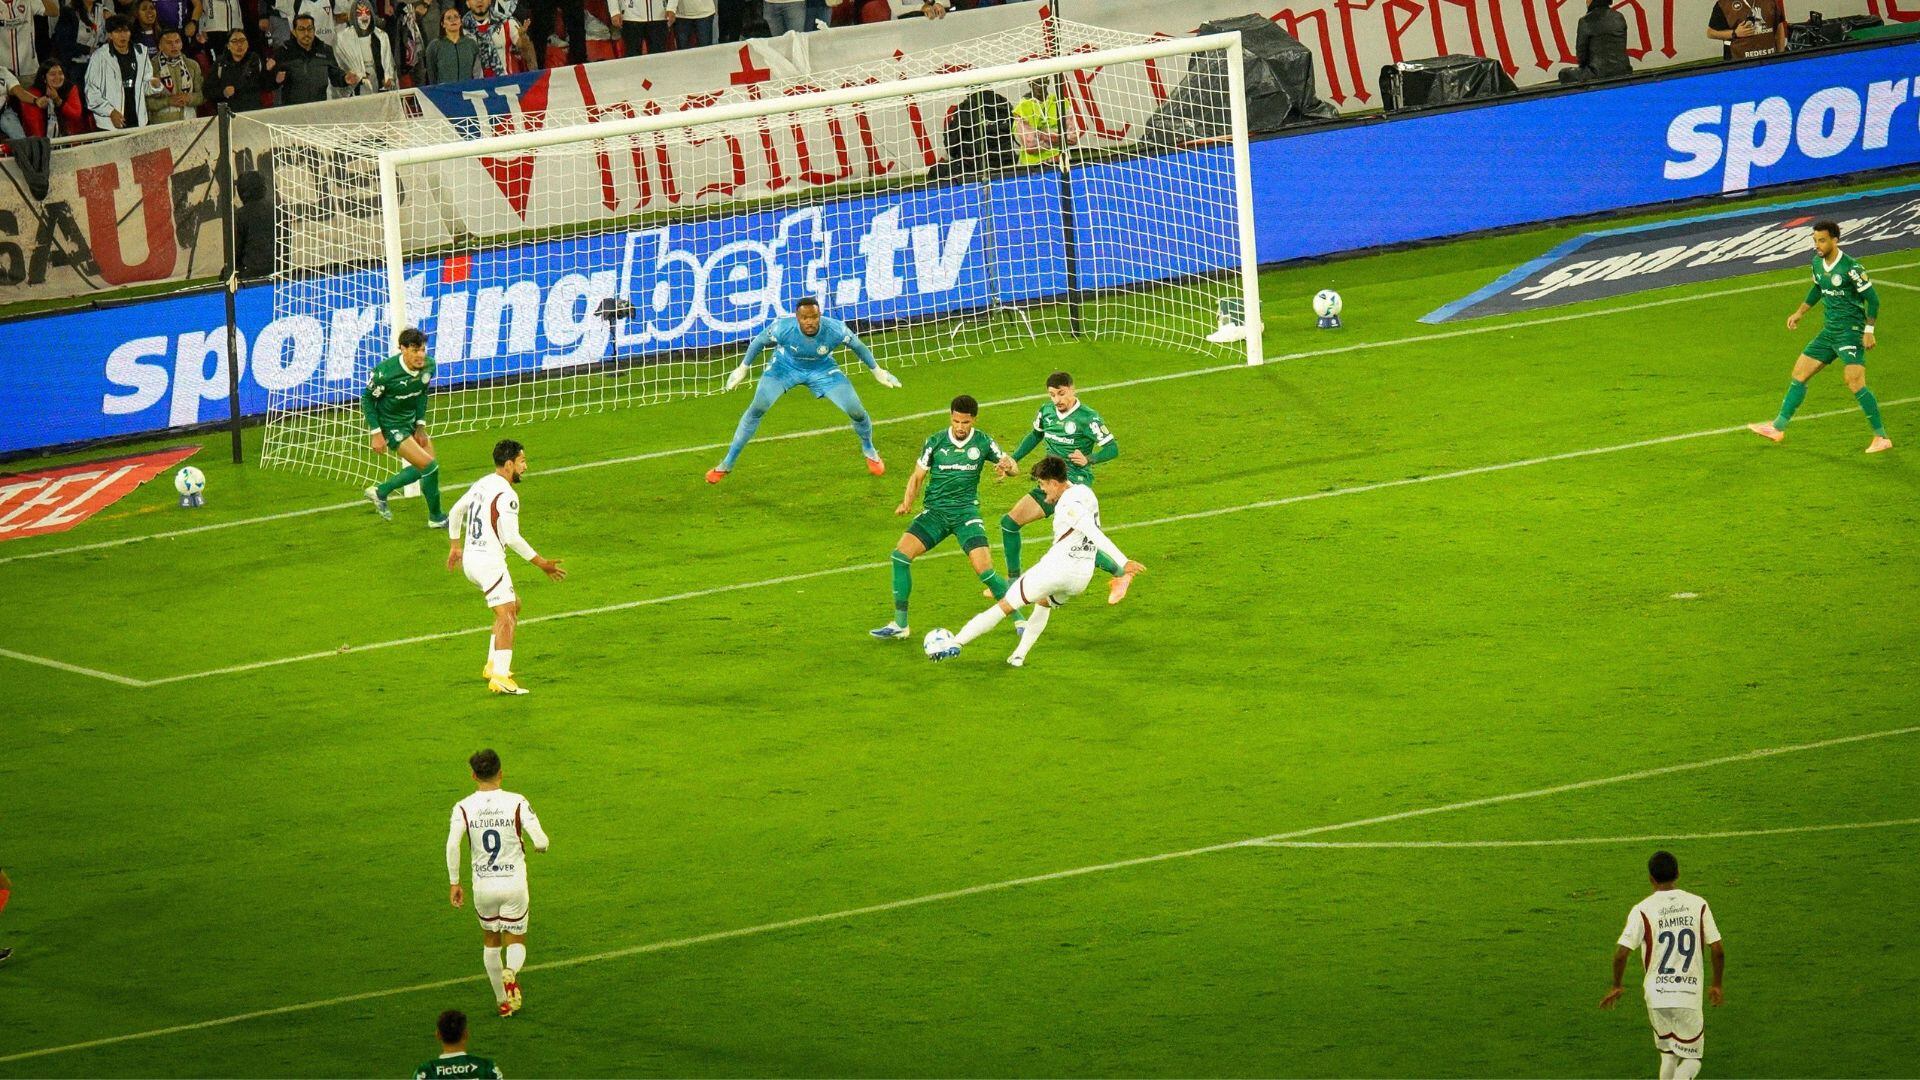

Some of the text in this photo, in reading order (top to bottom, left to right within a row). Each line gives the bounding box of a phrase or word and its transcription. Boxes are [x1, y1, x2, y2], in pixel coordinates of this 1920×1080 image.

[1664, 76, 1920, 197] spor
[102, 205, 978, 427] sportingbet.tv
[470, 818, 515, 829] ALZUGARAY
[482, 829, 501, 867] 9
[1658, 915, 1694, 929] RAMIREZ
[1658, 928, 1696, 975] 29
[1656, 975, 1698, 985] DISCOVER
